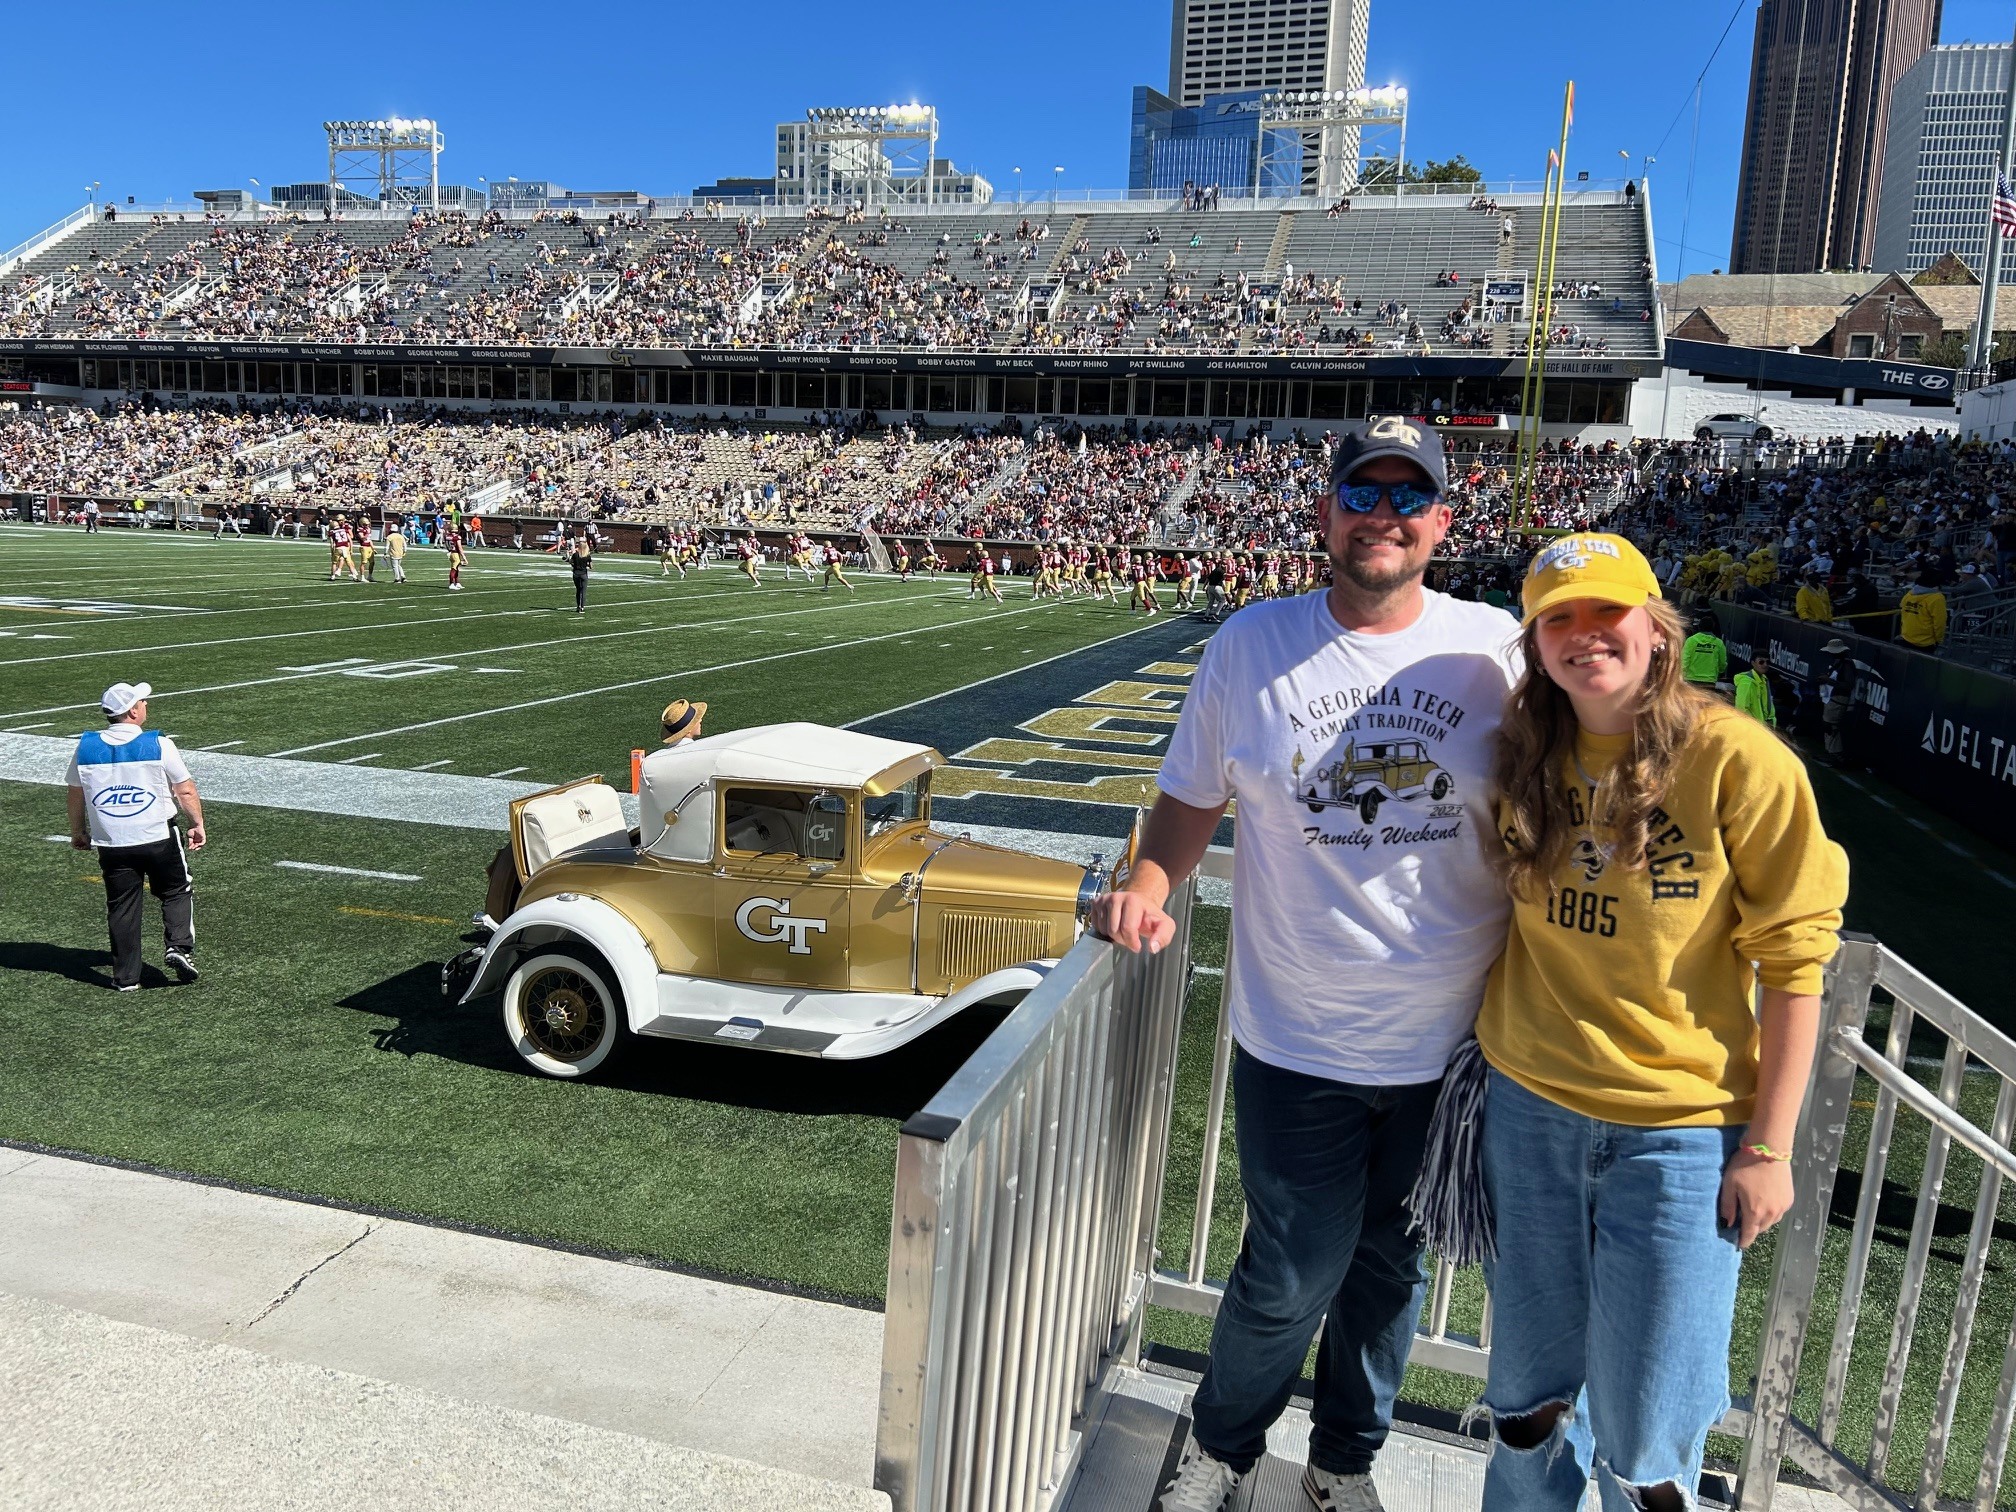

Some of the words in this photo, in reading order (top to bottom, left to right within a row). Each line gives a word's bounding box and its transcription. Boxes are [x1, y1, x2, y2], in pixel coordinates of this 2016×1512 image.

[231, 346, 256, 354] EVERETT
[258, 346, 289, 354] STRUPPER
[300, 347, 314, 355] BILL
[315, 347, 342, 355] FINCHER
[354, 348, 374, 356] BOBBY
[376, 348, 395, 356] DAVIS
[408, 349, 432, 357] GEORGE
[433, 349, 459, 357] MORRIS
[472, 350, 498, 358] GEORGE
[500, 350, 531, 358] GARDNER
[701, 354, 722, 363] MAXIE
[724, 354, 759, 363] BAUGHAN
[777, 356, 800, 364] LARRY
[802, 356, 831, 364] MORRIS
[850, 358, 874, 366] BOBBY
[876, 358, 898, 366] DODD
[918, 358, 942, 367] BOBBY
[944, 358, 976, 367] GASTON
[996, 360, 1010, 368] RAY
[1013, 360, 1034, 368] BECK
[1054, 360, 1082, 368] RANDY
[1084, 360, 1108, 368] RHINO
[1129, 361, 1144, 369] PAT
[1146, 361, 1185, 369] SWILLING
[1206, 362, 1222, 370] JOE
[1224, 362, 1268, 370] HAMILTON
[1290, 362, 1320, 370] CALVIN
[1322, 362, 1365, 370] JOHNSON
[1529, 362, 1559, 373] COLEGE
[1561, 363, 1579, 373] HALL
[1582, 364, 1591, 373] OF
[1592, 364, 1613, 374] FAME
[1882, 369, 1915, 386] THE
[1436, 416, 1450, 424] GT
[1452, 416, 1494, 425] SEATGEEK
[1368, 415, 1422, 448] GT
[275, 658, 459, 680] 10
[1288, 712, 1305, 733] A
[1308, 686, 1401, 720] GEORGIA
[1414, 689, 1466, 730] TECH
[1310, 713, 1361, 743] FAMILY
[1367, 713, 1448, 743] TRADITION
[1940, 719, 2016, 787] DELTA
[100, 792, 146, 806] ACC
[1430, 805, 1463, 818] 2023
[808, 823, 834, 842] GT
[1304, 826, 1374, 851] Family
[1380, 821, 1462, 844] Weekend
[1547, 887, 1619, 938] 1885
[735, 896, 827, 955] GT
